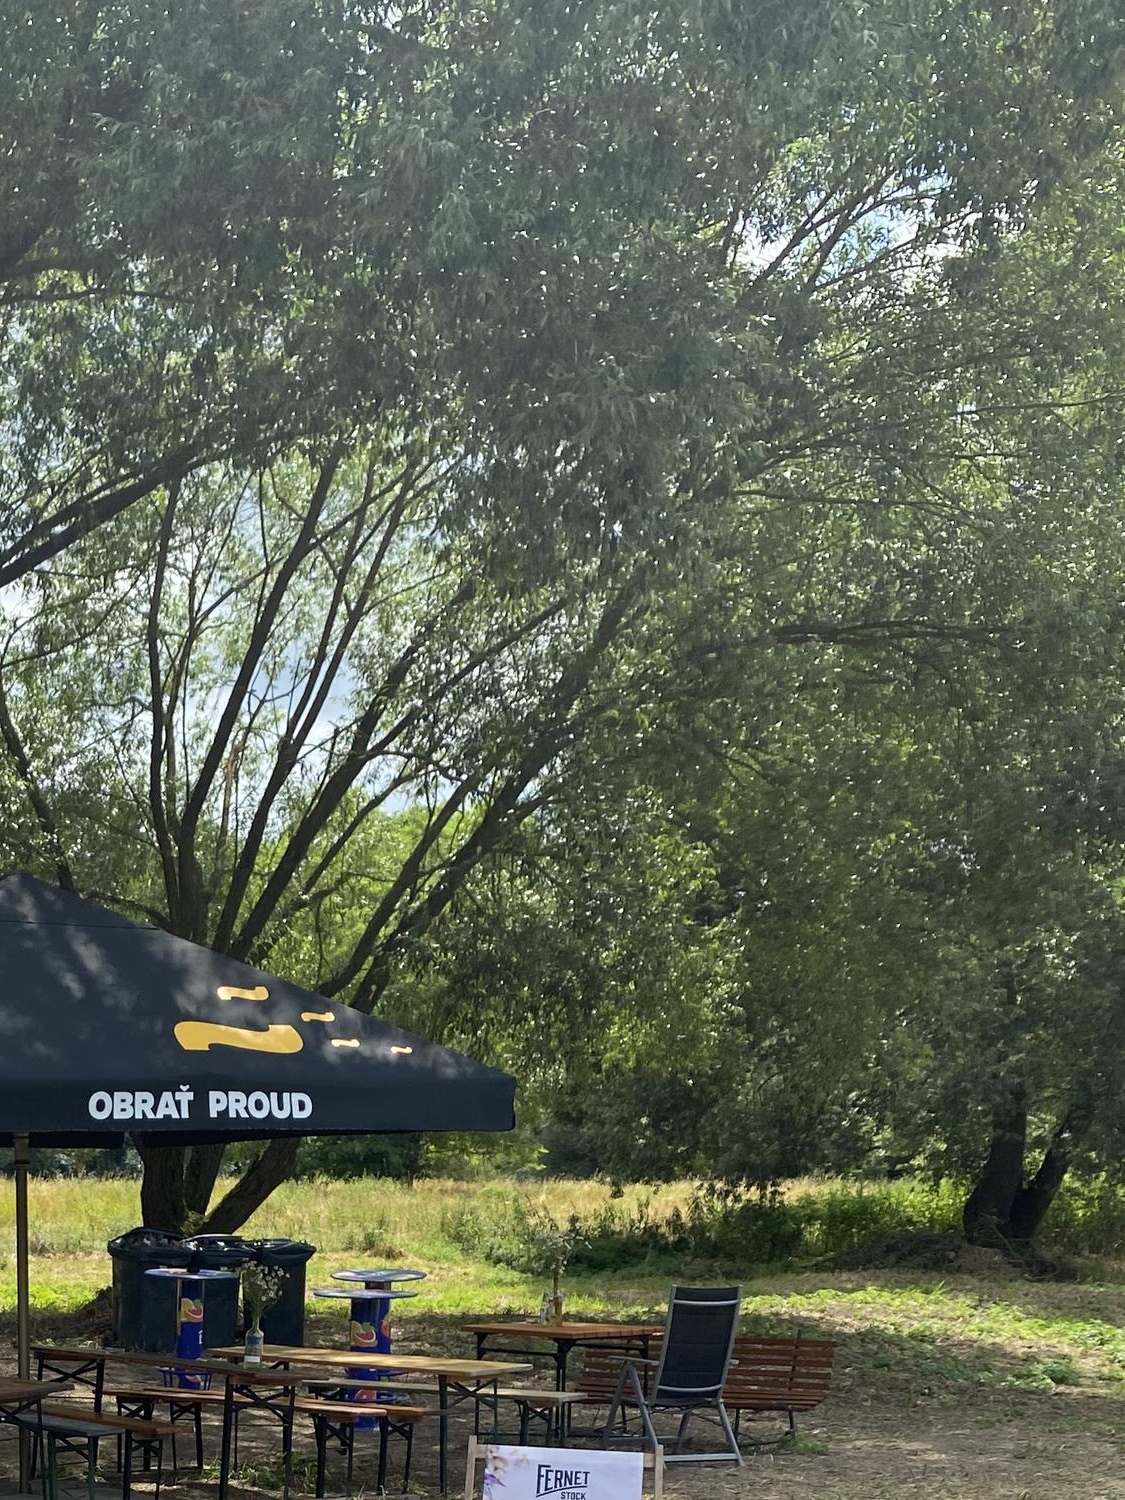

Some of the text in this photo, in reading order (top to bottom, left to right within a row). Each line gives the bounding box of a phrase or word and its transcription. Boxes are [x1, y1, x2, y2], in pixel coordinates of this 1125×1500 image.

[88, 1084, 313, 1119] OBRAŤ PROUD
[536, 1464, 590, 1496] FERNET
[560, 1491, 586, 1500] STOCK
